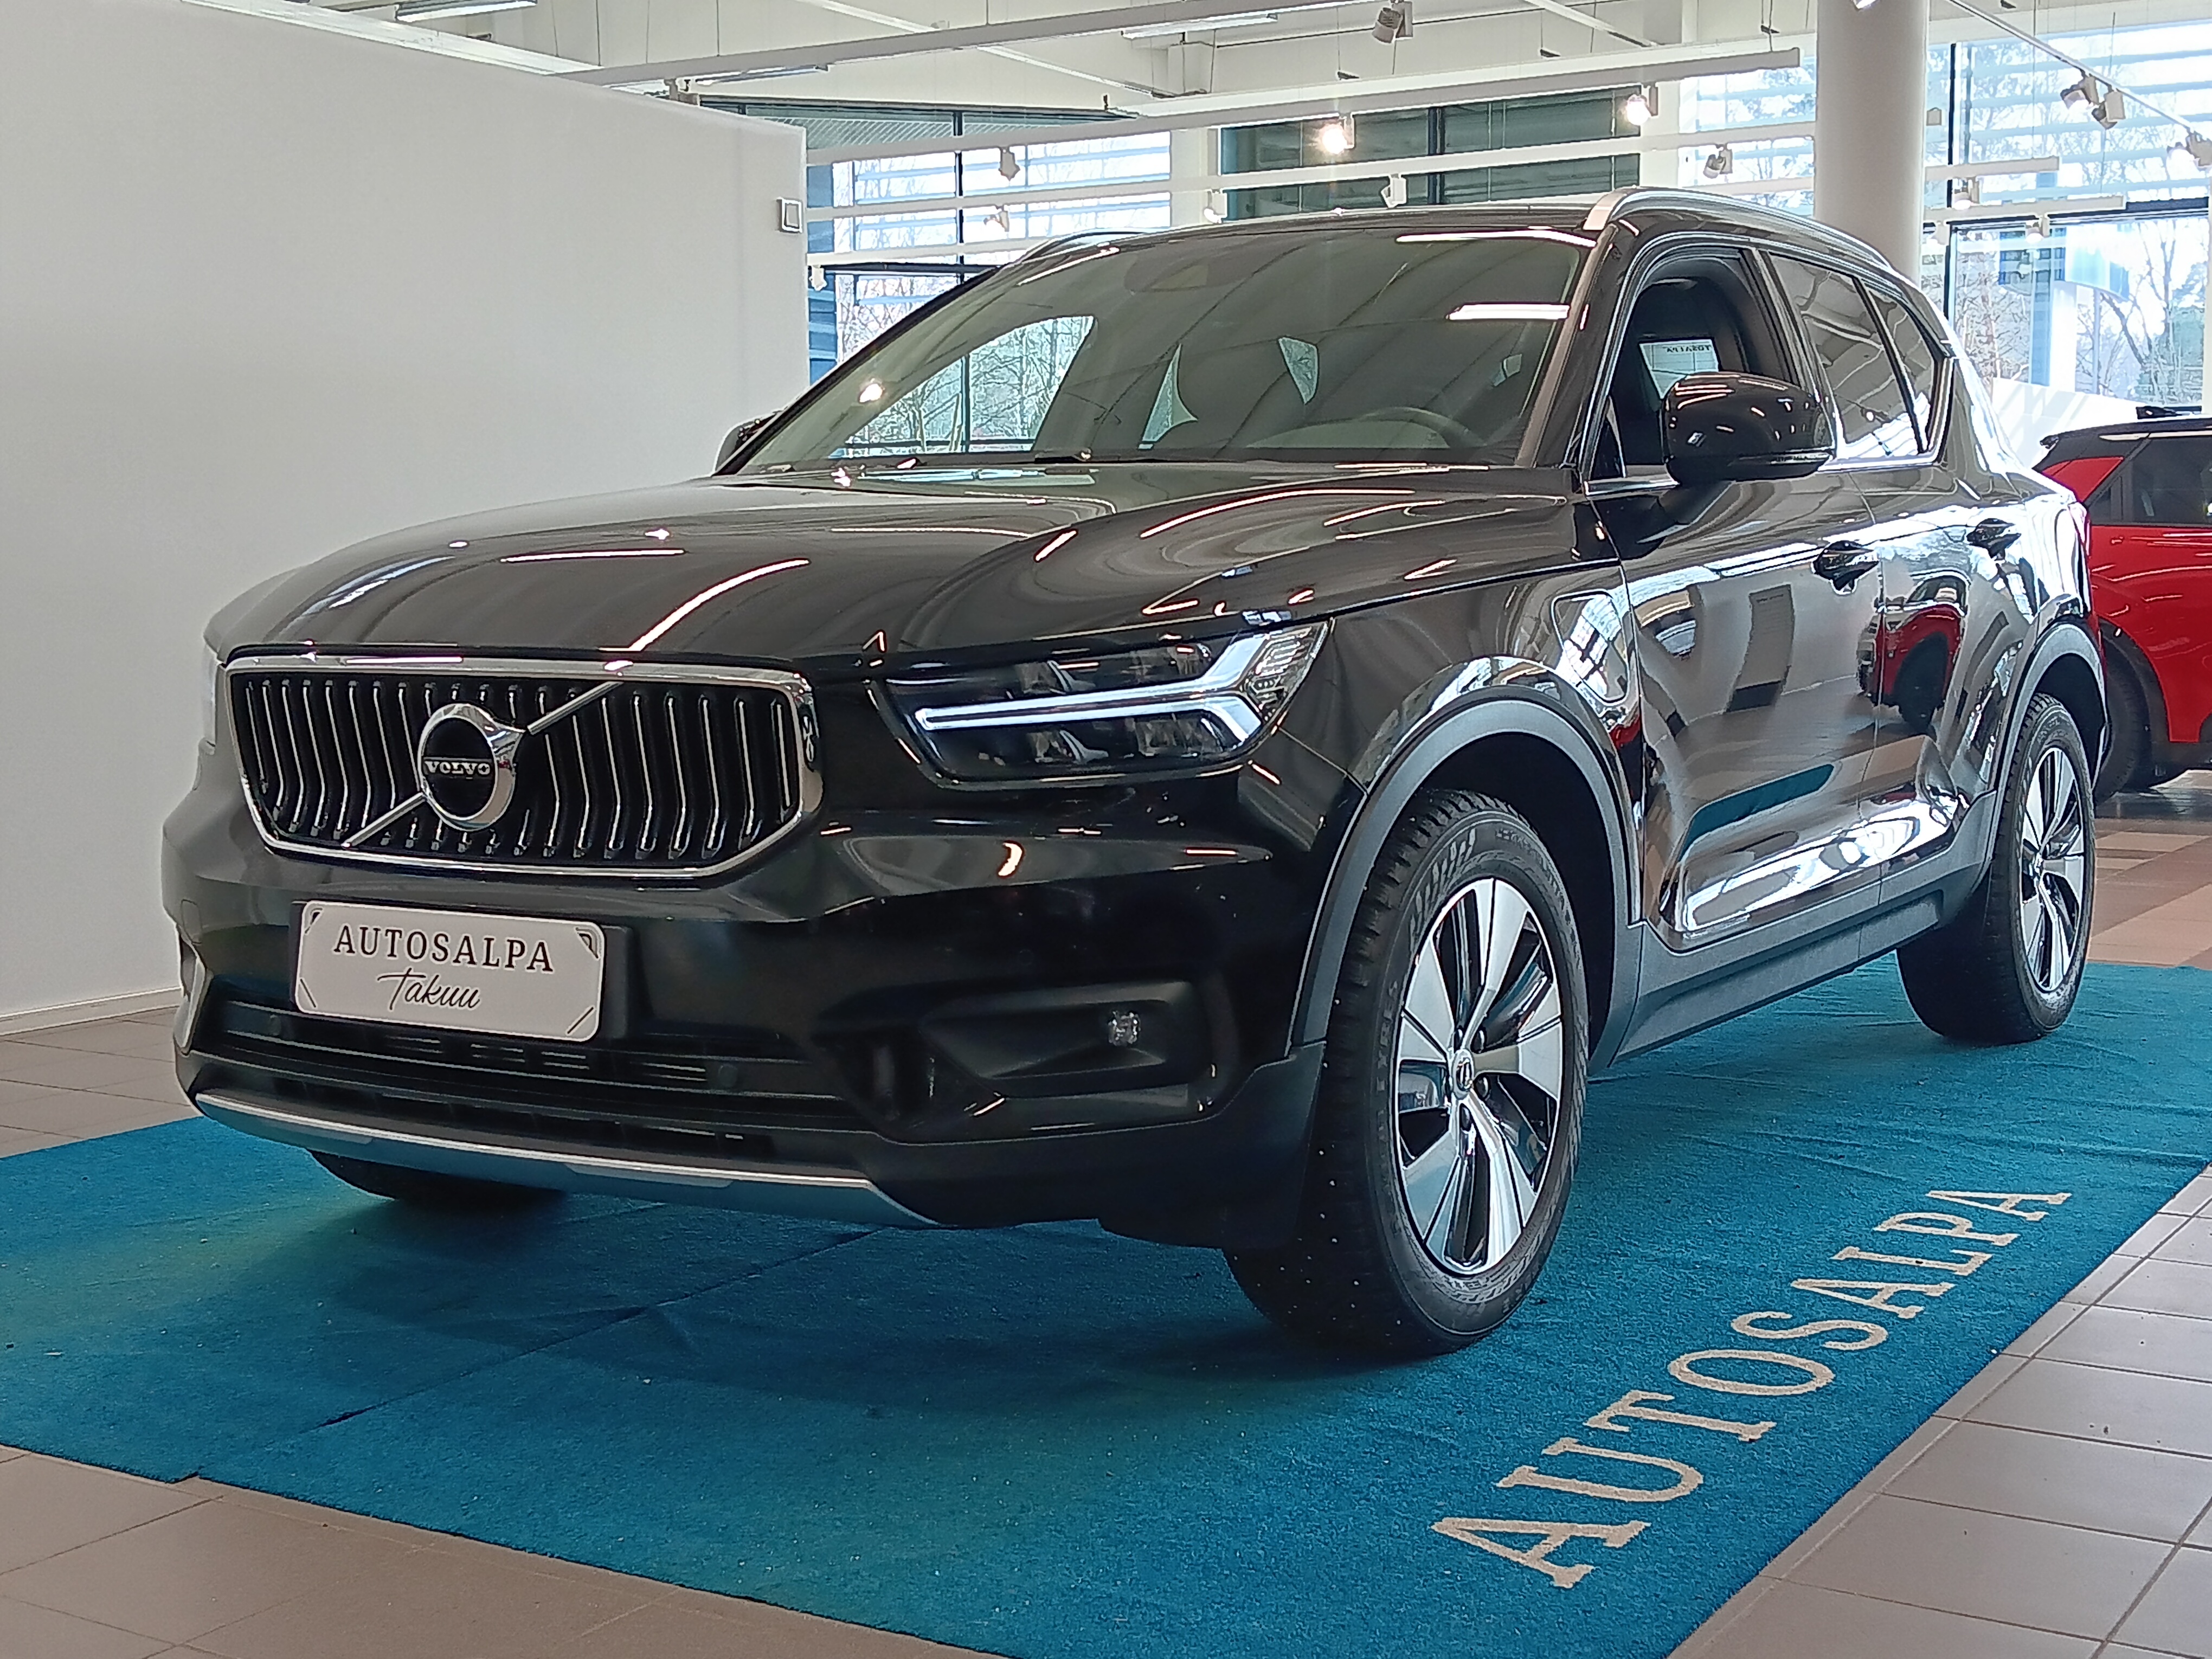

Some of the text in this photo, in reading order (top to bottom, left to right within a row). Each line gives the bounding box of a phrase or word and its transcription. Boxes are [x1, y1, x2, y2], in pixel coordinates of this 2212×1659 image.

[424, 761, 491, 775] VOLVO
[333, 925, 554, 972] AUTOSALPA
[377, 967, 481, 1011] Takuu
[1430, 1190, 2073, 1589] AUTOSALPA
